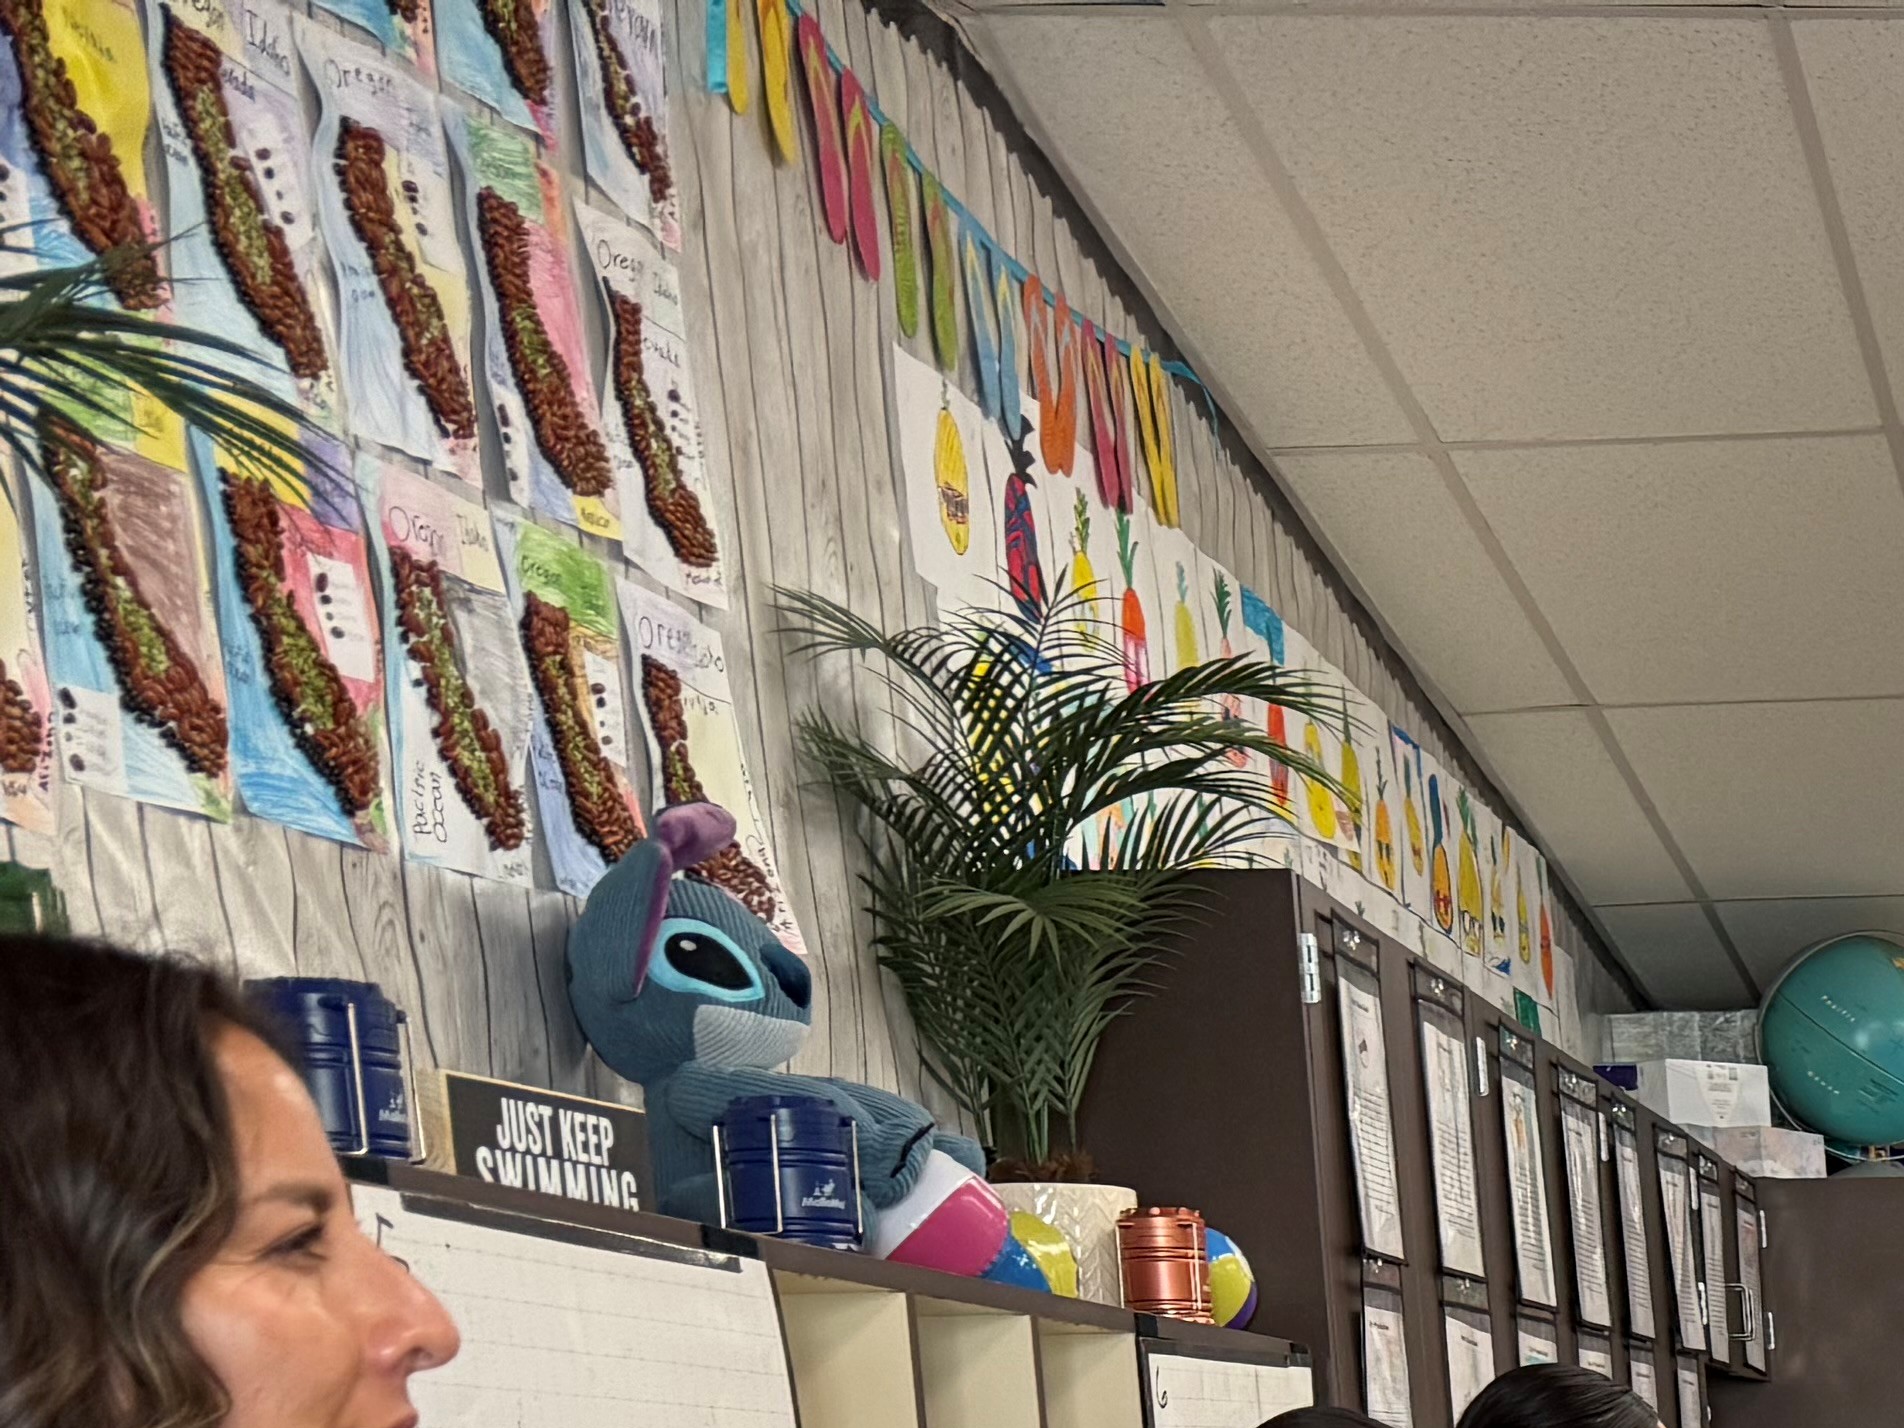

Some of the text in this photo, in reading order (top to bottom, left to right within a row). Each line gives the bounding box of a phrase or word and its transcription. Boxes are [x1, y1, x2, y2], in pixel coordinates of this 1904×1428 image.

[495, 1096, 615, 1168] JUST KEEP
[475, 1145, 639, 1213] SWIMMING
